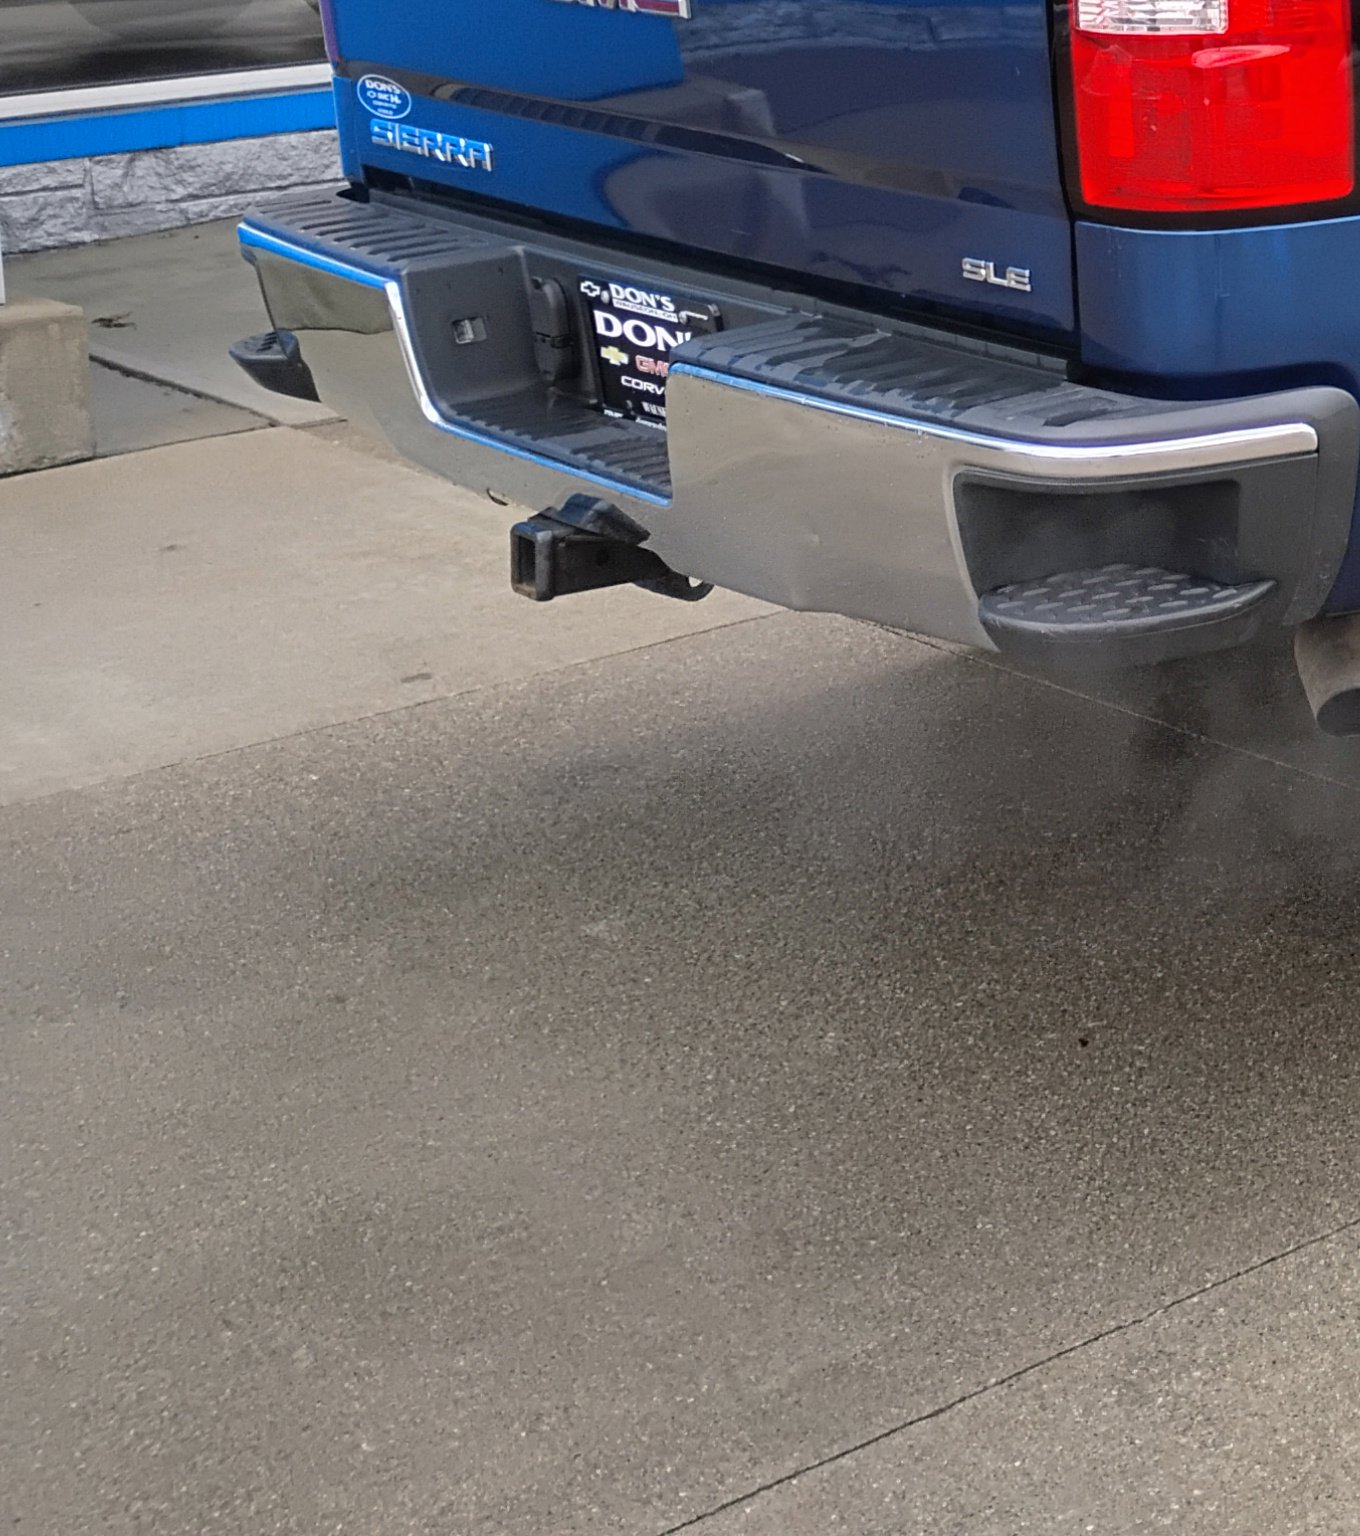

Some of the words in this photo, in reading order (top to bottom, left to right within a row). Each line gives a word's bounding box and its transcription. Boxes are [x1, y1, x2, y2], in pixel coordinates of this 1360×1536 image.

[369, 118, 494, 172] SIERRA
[961, 257, 1032, 292] SLE
[608, 283, 676, 312] DON'S
